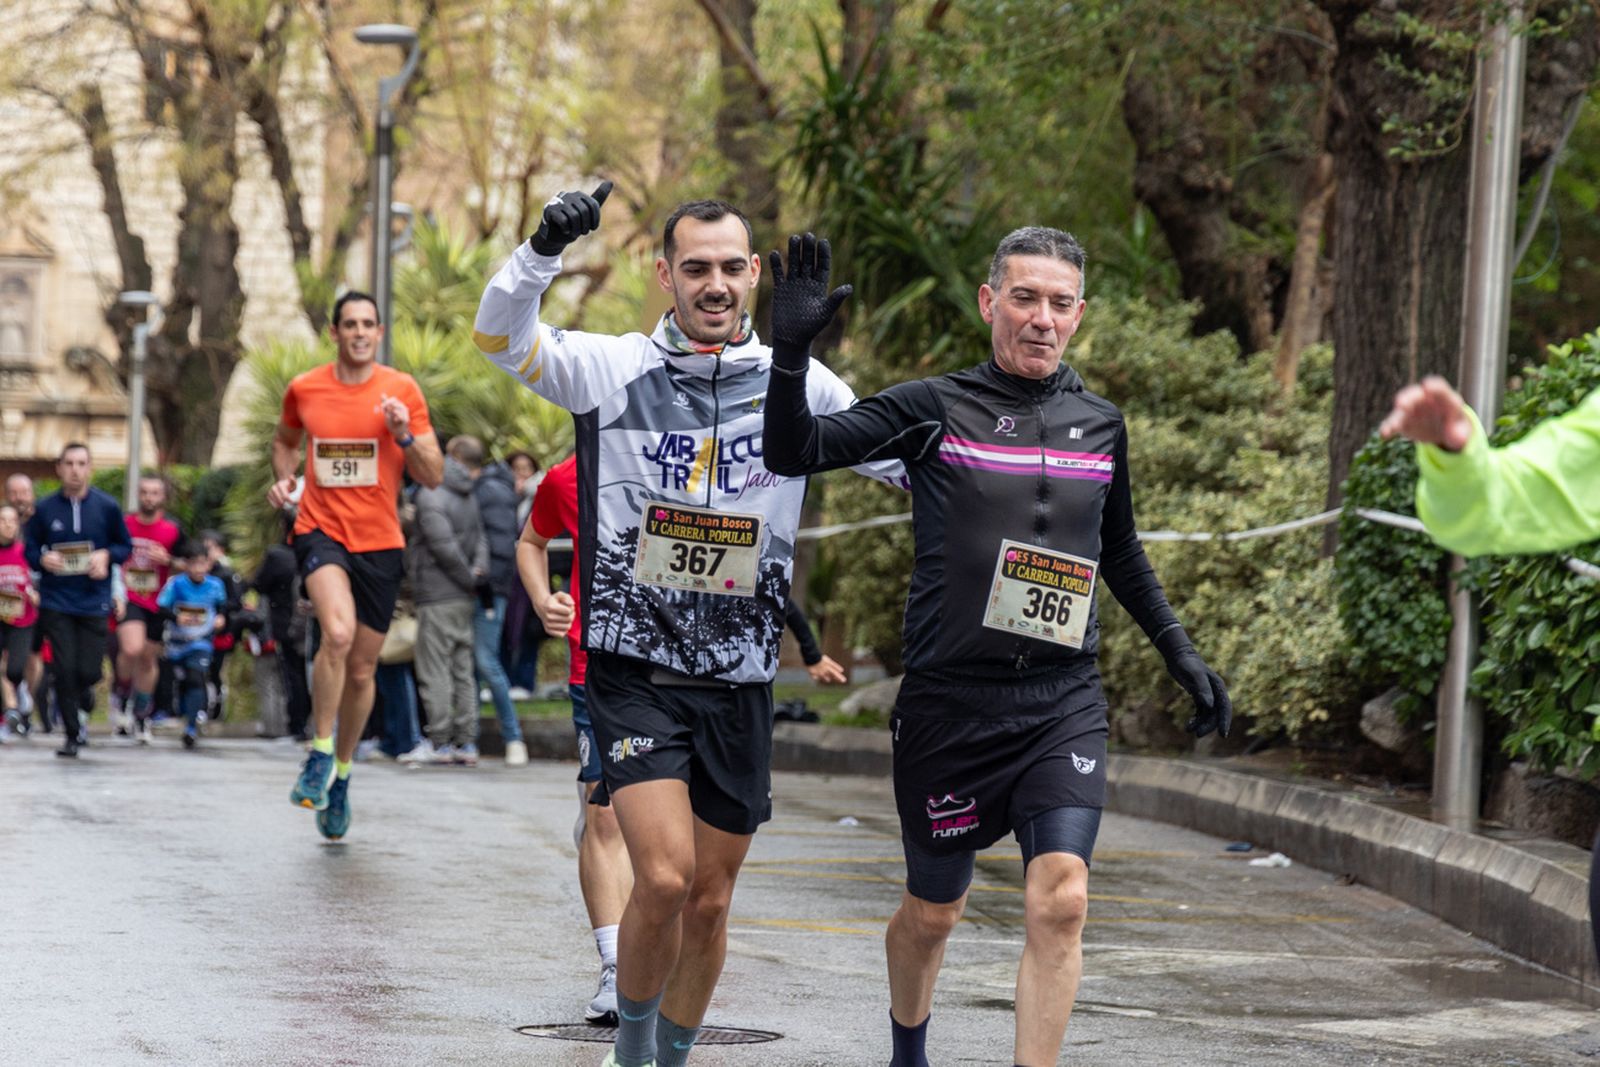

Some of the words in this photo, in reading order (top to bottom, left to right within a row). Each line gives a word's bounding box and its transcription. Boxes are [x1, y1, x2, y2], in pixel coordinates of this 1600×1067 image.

[642, 432, 764, 466] JABALCU
[332, 461, 358, 477] 591
[650, 520, 658, 532] V
[660, 522, 705, 540] CARRERA
[709, 529, 753, 544] POPULAR
[673, 511, 692, 524] San
[695, 514, 720, 527] Juan
[722, 517, 752, 529] Bosco
[669, 543, 728, 577] 367
[1014, 549, 1030, 564] ES
[1031, 552, 1050, 568] San
[1052, 559, 1073, 573] Juan
[1073, 563, 1092, 580] Bos
[1007, 563, 1016, 575] V
[1017, 565, 1059, 586] CARRERA
[1022, 587, 1073, 626] 366
